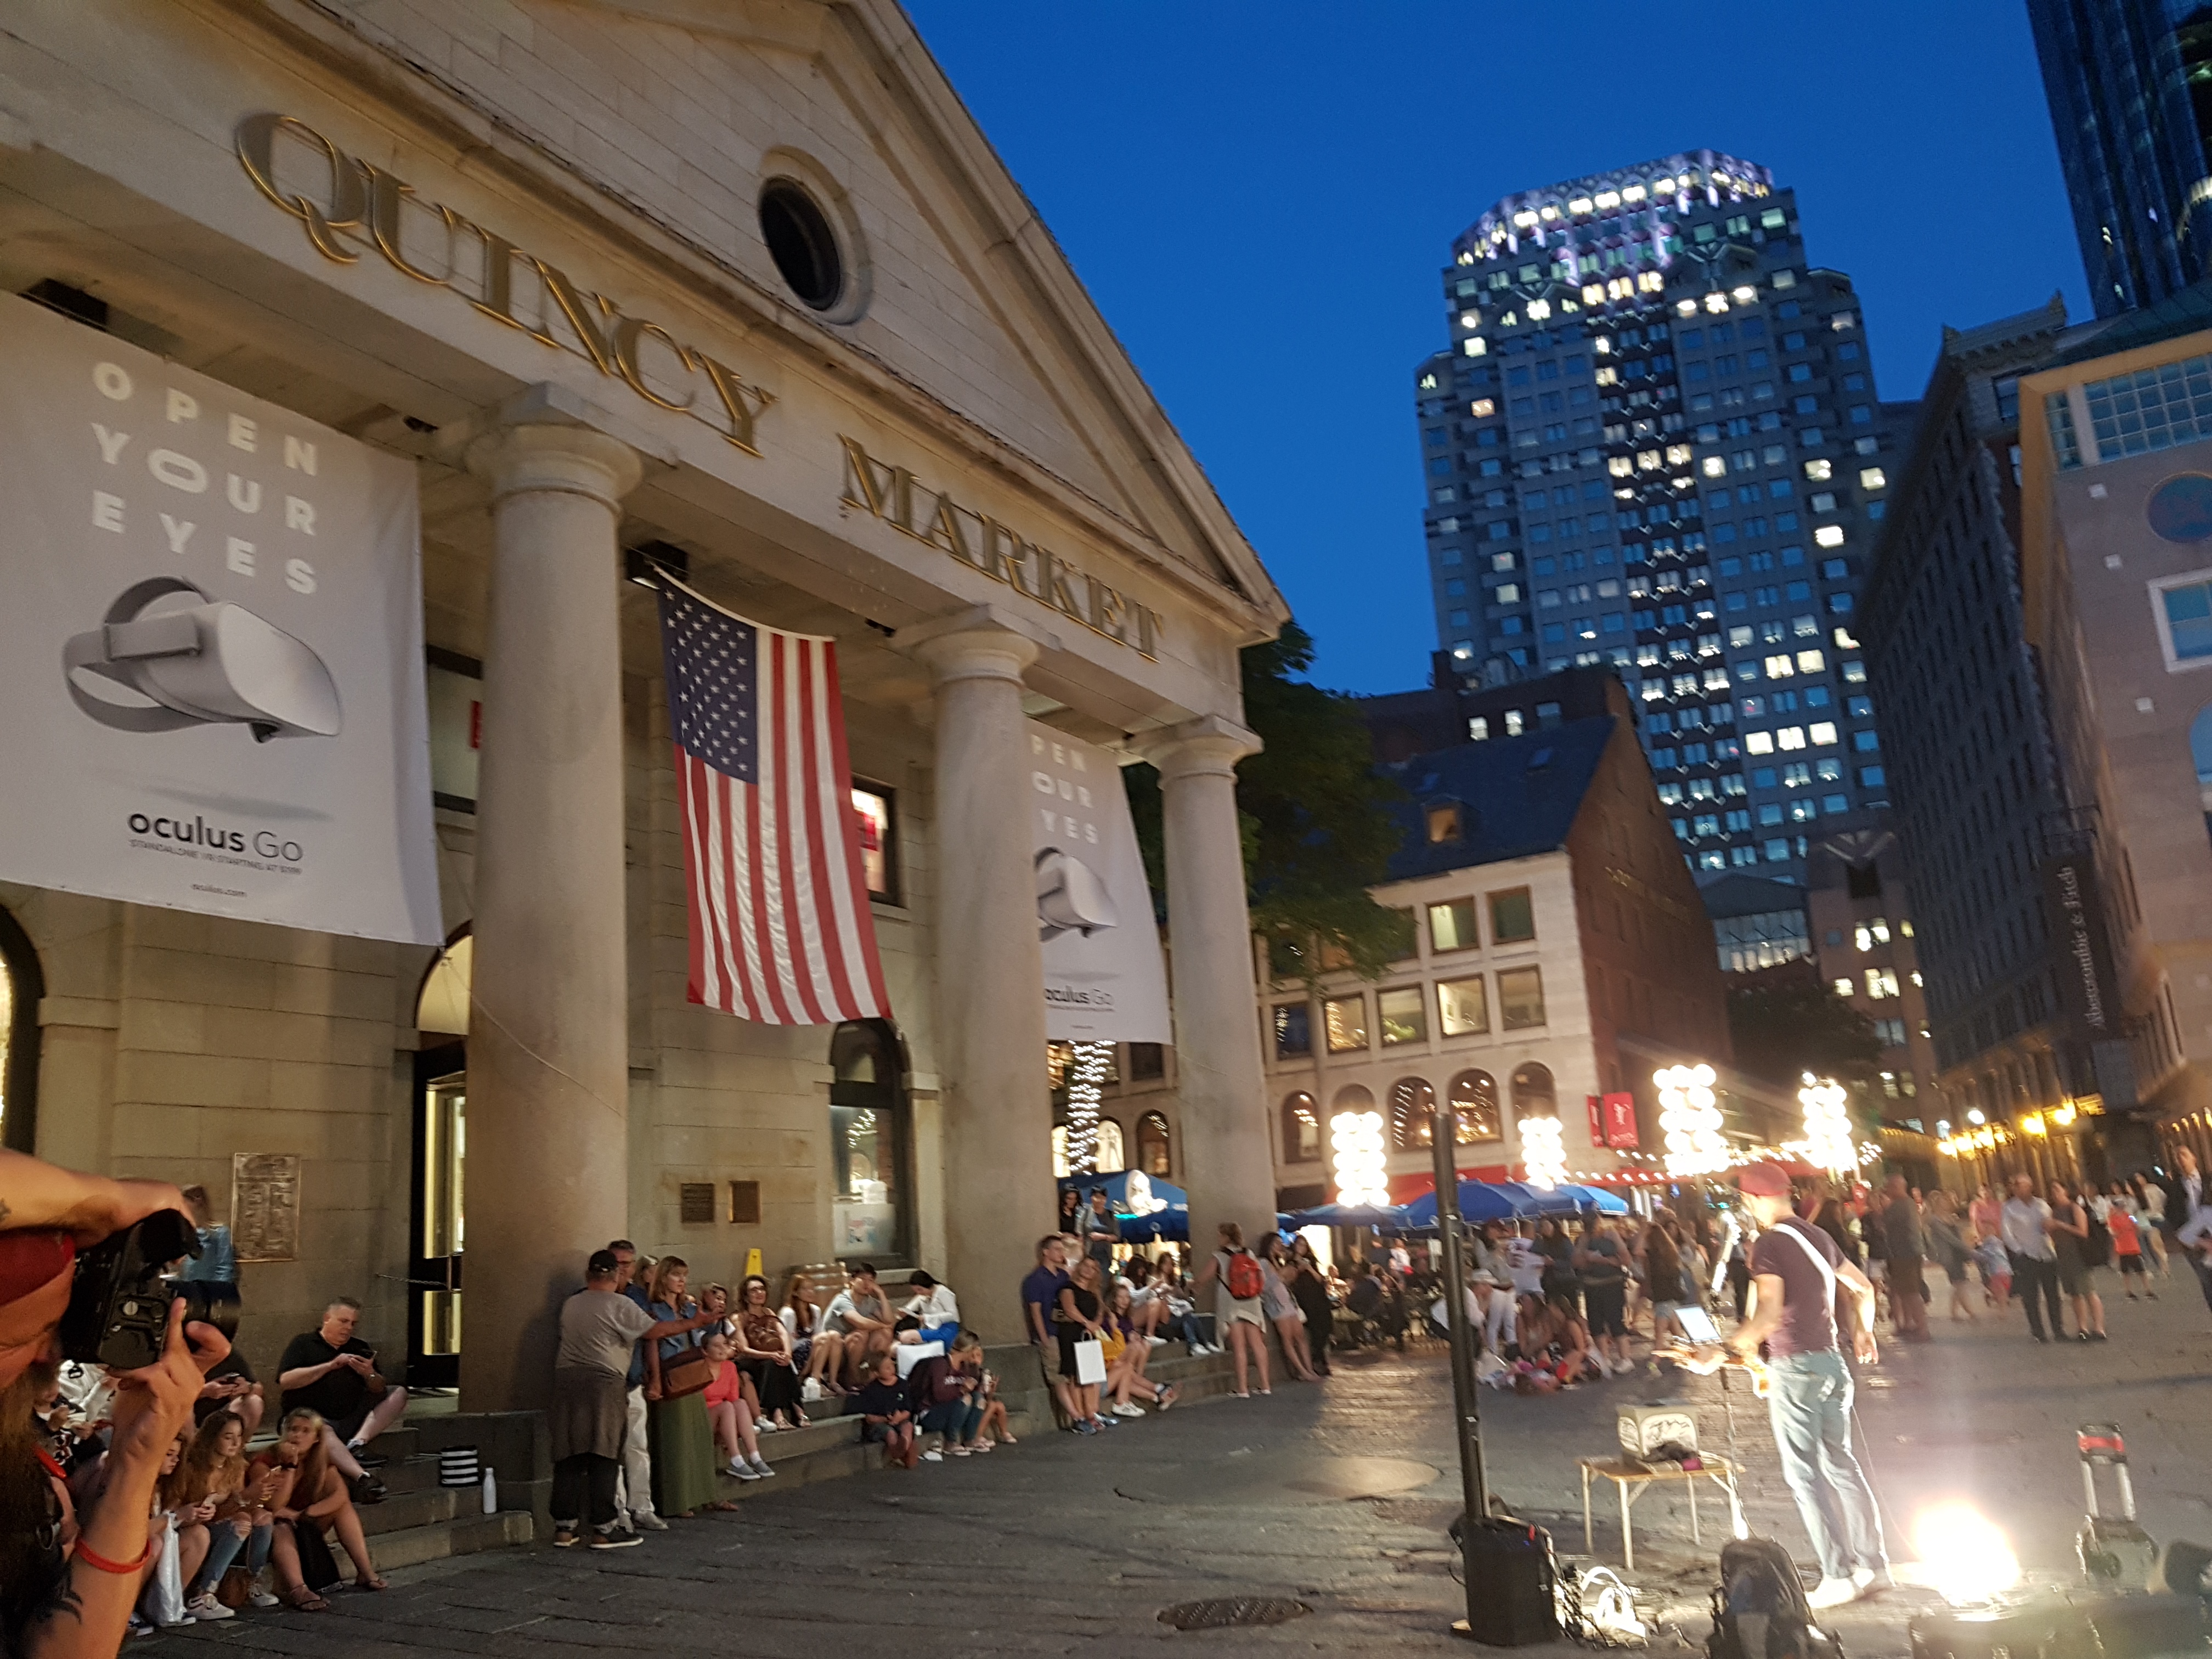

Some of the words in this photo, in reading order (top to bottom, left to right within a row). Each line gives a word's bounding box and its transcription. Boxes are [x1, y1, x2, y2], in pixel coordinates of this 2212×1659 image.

[93, 362, 317, 476] OPEN
[233, 112, 780, 459] QUINCY
[836, 432, 1164, 663] MARKET
[92, 423, 317, 536] YOUR
[92, 490, 317, 595] EYES
[1031, 733, 1087, 772] PEN
[1031, 770, 1094, 809] OUR
[127, 814, 246, 852] oculus
[252, 831, 303, 861] Go
[1040, 808, 1098, 845] YES
